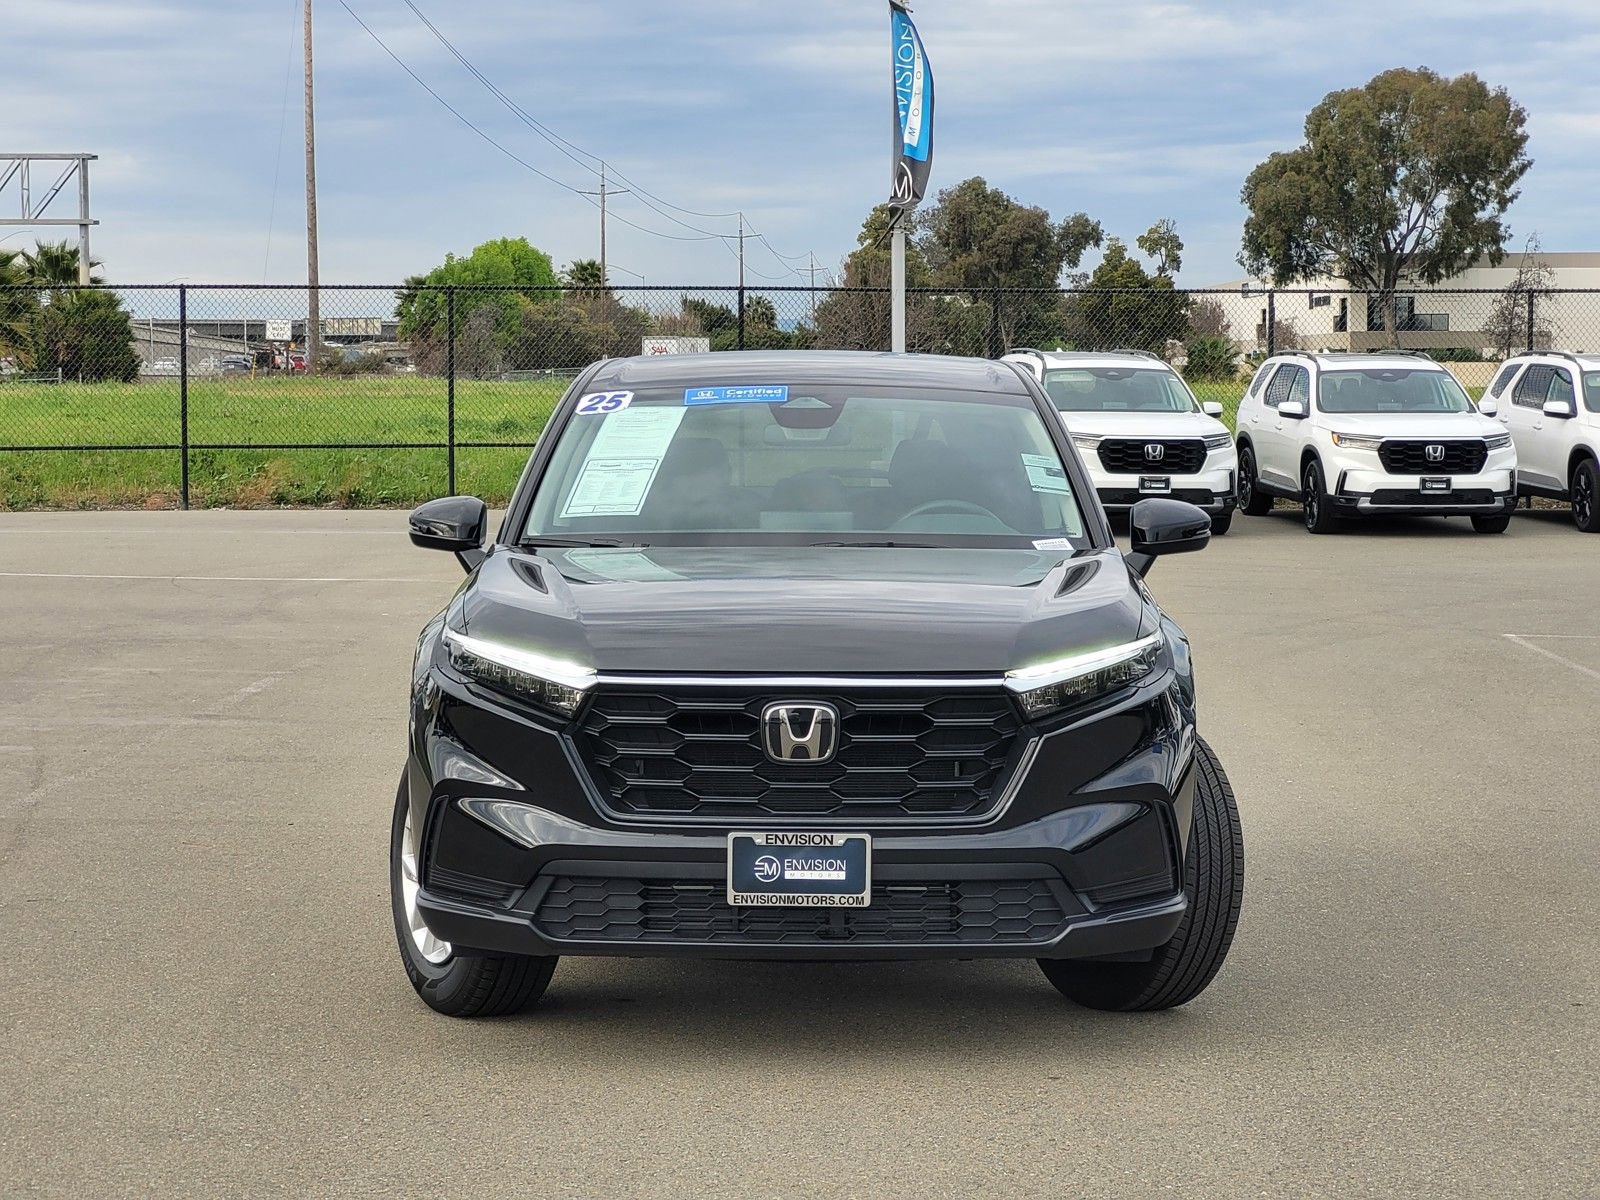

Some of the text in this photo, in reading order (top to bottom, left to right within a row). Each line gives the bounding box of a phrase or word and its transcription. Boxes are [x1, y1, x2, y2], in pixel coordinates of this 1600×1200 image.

[726, 387, 782, 395] Certified
[579, 393, 625, 412] 25
[765, 834, 834, 845] ENVISION
[784, 859, 847, 871] ENVISION
[733, 894, 865, 906] ENVISIONMOTORS.COM
